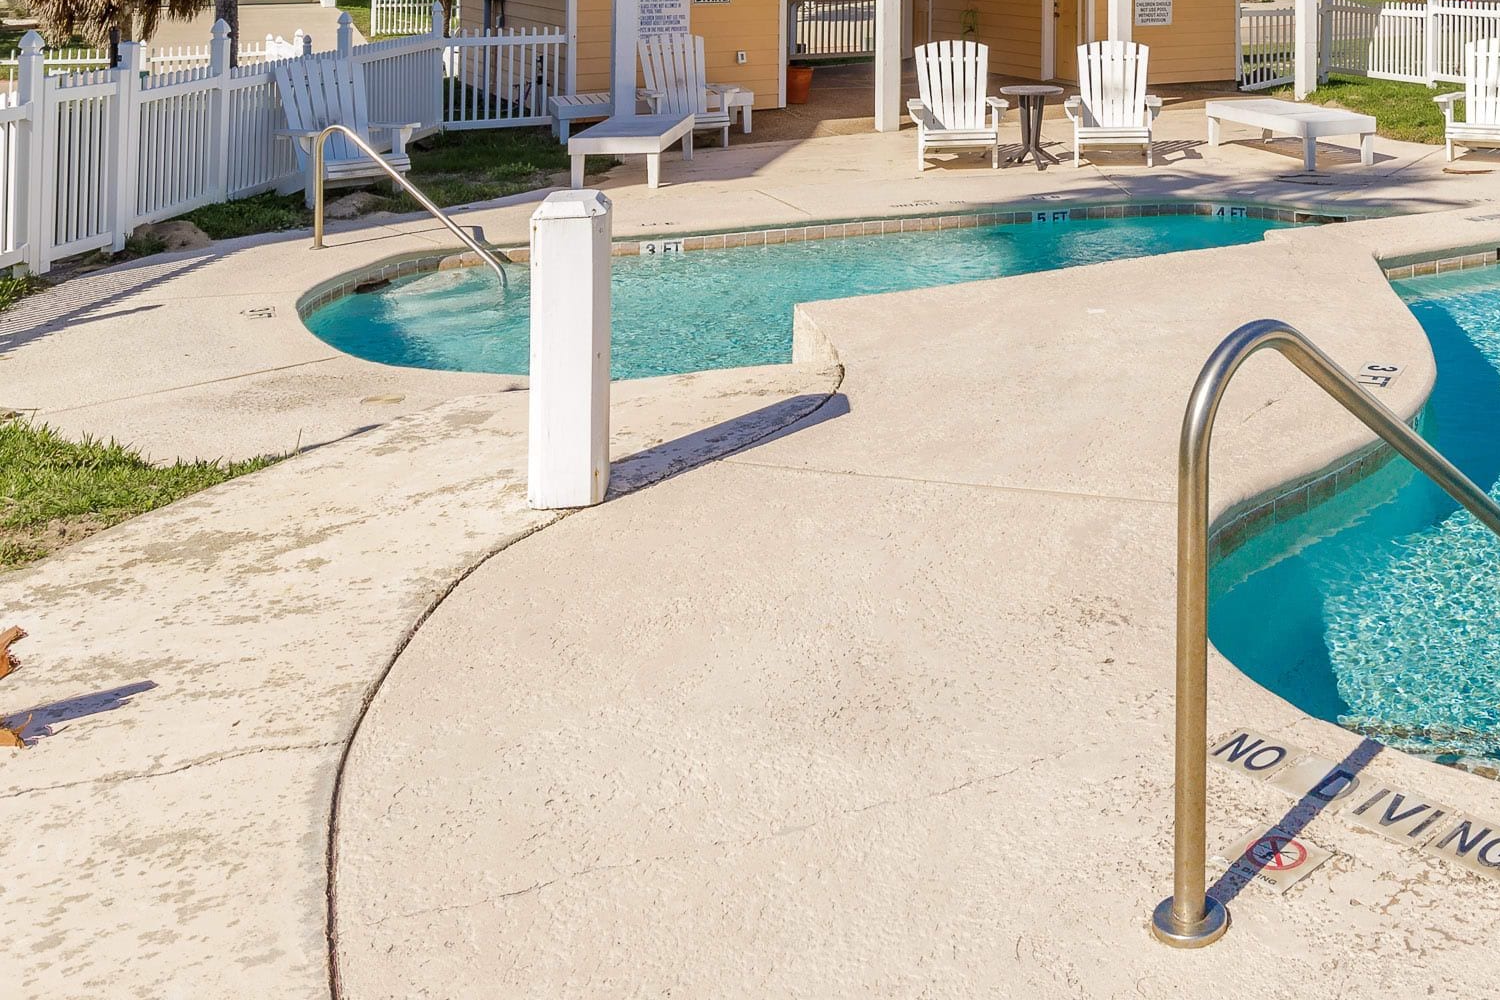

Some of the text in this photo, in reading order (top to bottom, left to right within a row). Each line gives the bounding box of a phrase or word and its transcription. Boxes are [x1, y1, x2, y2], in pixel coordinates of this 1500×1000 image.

[1037, 211, 1068, 222] 5 FT
[1216, 207, 1245, 216] 4 FT
[646, 241, 681, 255] 3 FT
[1358, 375, 1391, 387] FT
[1211, 733, 1287, 771] NO
